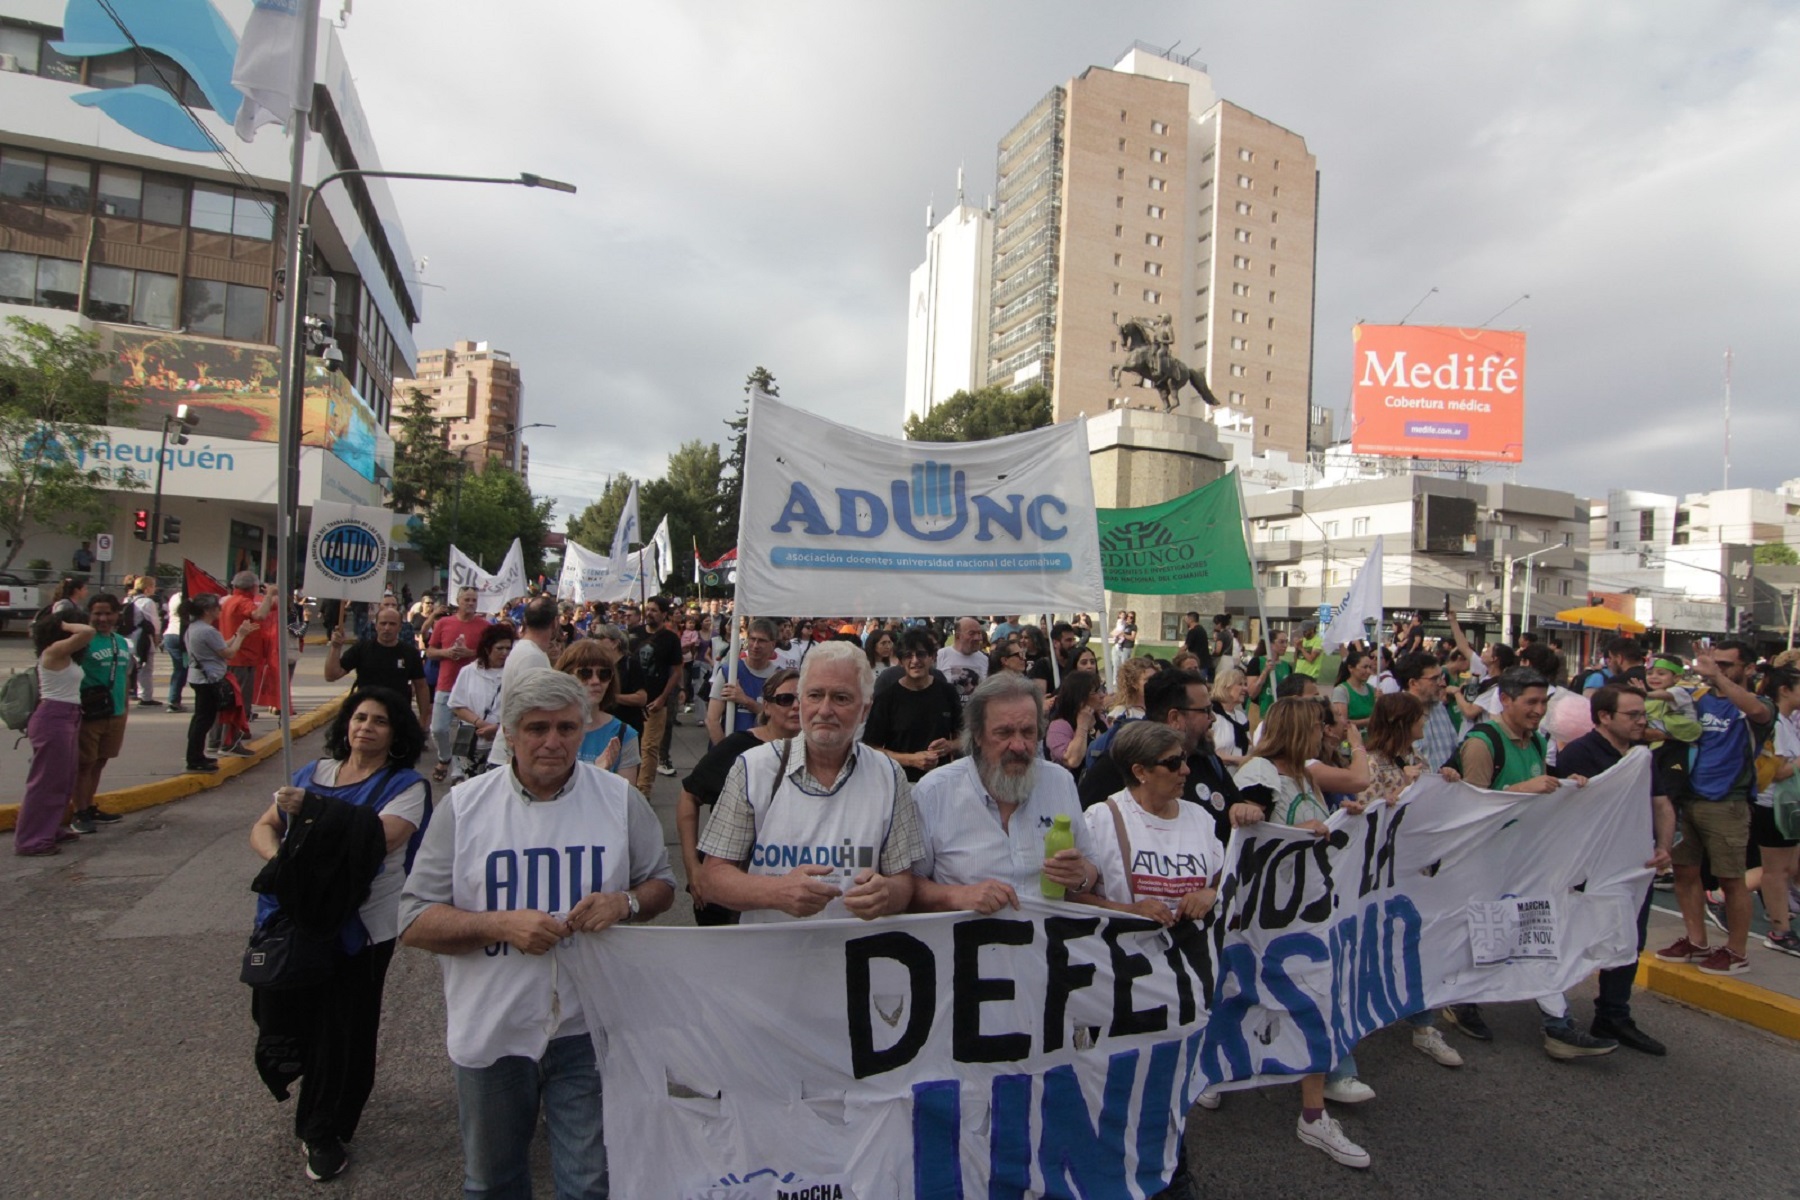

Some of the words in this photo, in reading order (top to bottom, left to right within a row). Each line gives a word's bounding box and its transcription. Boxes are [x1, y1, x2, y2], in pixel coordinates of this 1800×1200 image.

[1359, 350, 1518, 394] Medifé
[1384, 395, 1444, 410] Cobertura
[1447, 398, 1491, 413] médica
[1411, 425, 1462, 436] medife.com.ar
[93, 441, 234, 471] neuquén
[771, 469, 1068, 541] ADUNC
[324, 529, 376, 573] FATUN
[785, 552, 843, 564] asociación
[846, 553, 893, 566] docentes
[896, 555, 954, 567] universidad
[956, 556, 999, 568] nacional
[1000, 556, 1016, 567] del
[1018, 556, 1061, 567] comahue
[1359, 802, 1411, 899] LA
[1517, 900, 1550, 912] MARCHA
[1523, 931, 1531, 945] DE
[1533, 931, 1555, 945] NOV.
[777, 1184, 843, 1200] MARCHA
